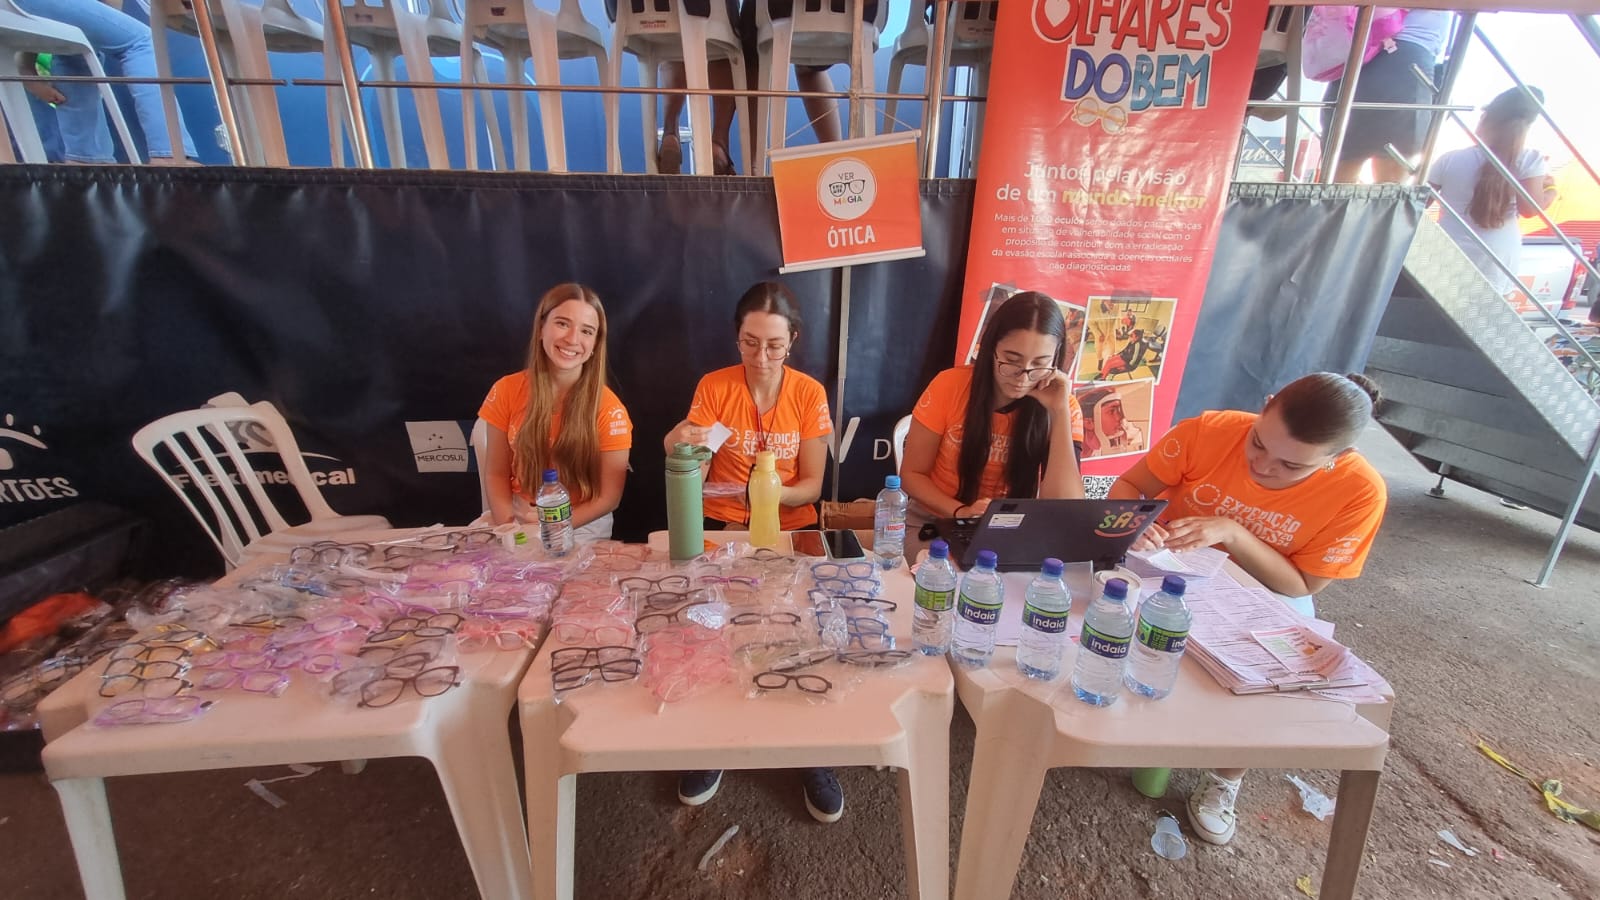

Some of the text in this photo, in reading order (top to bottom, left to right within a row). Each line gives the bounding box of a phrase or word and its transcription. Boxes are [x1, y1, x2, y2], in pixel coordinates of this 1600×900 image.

[1036, 0, 1229, 51] OLHARES
[838, 172, 854, 181] VER
[1024, 161, 1089, 181] Juntos
[1092, 165, 1133, 187] pela
[833, 195, 863, 206] MAGIA
[996, 183, 1207, 209] de um mundo melhor
[994, 213, 1016, 223] Mais
[1017, 215, 1028, 223] de
[1054, 216, 1084, 225] óculos
[827, 224, 876, 248] ÓTICA
[1001, 226, 1017, 234] em
[1056, 228, 1067, 236] de
[417, 454, 465, 462] MERCOSUL
[1098, 511, 1147, 529] SAS
[1221, 495, 1302, 533] EXPEDIÇÃO
